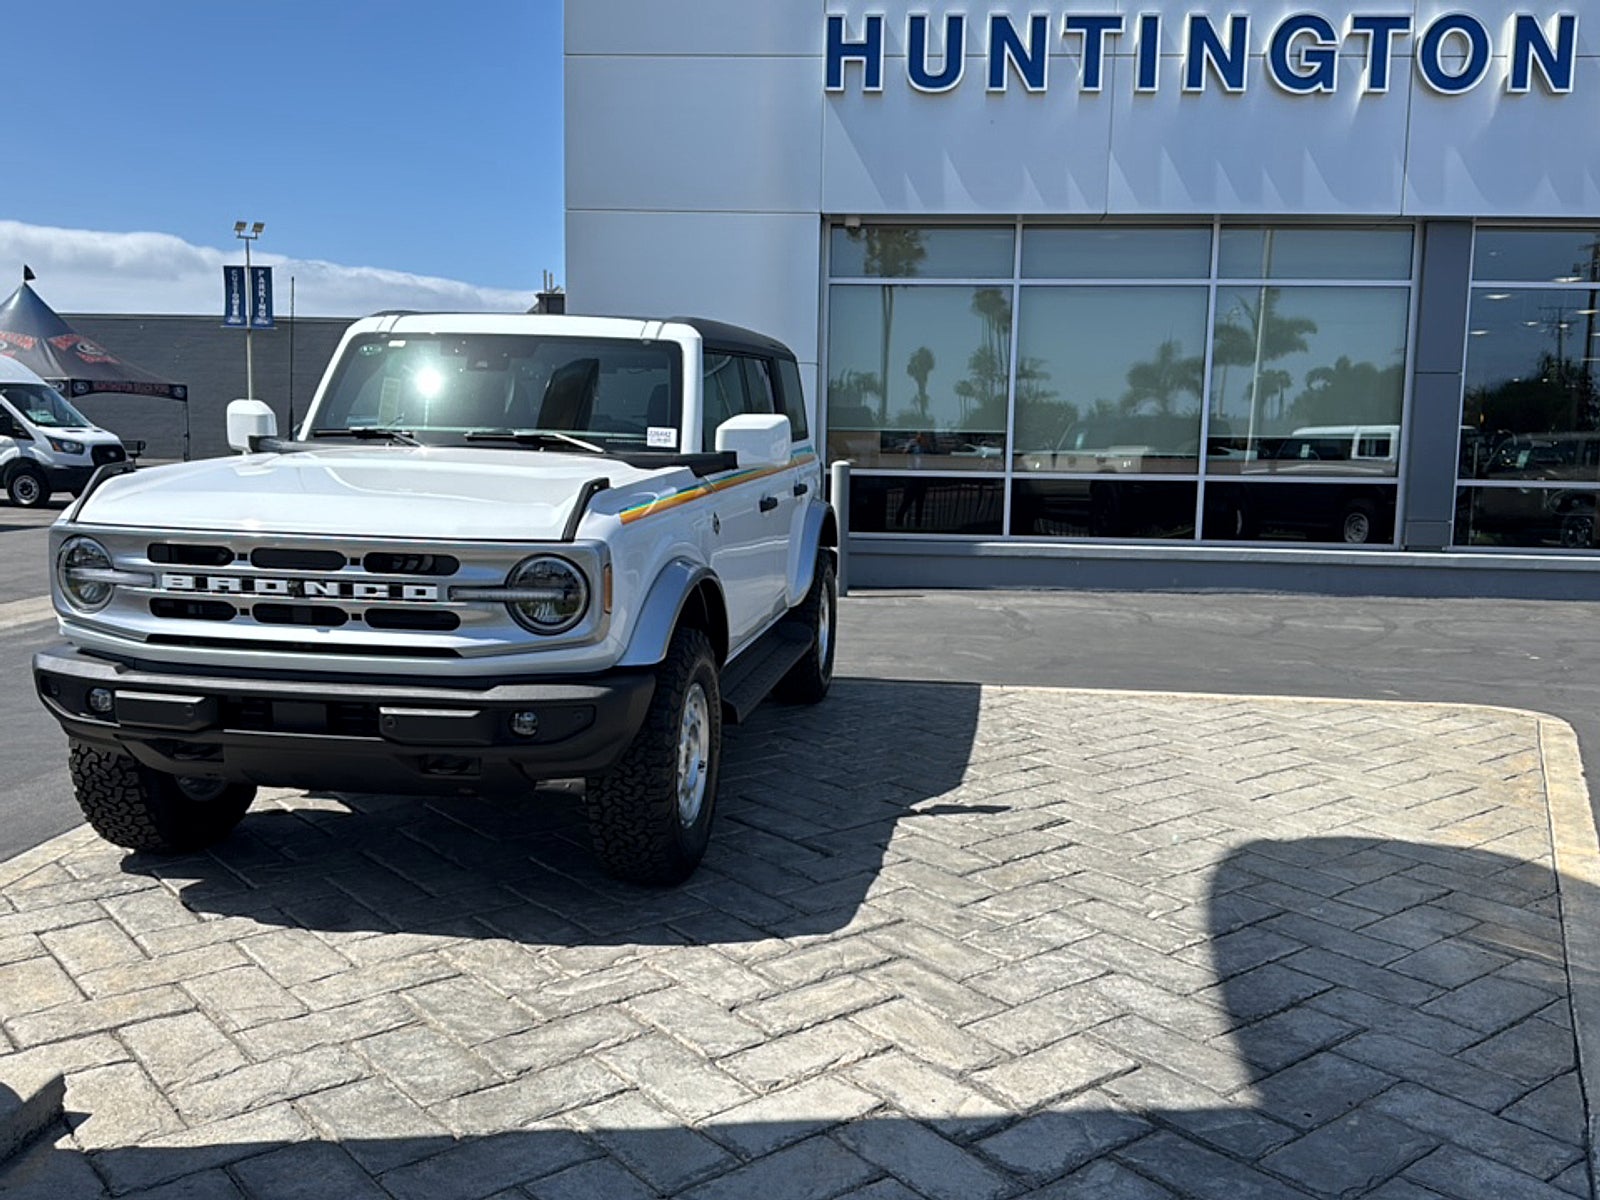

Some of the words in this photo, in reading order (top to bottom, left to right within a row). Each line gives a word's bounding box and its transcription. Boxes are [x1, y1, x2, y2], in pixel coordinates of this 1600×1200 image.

[824, 13, 1577, 94] HUNTINGTON
[258, 269, 266, 318] PARKING
[161, 573, 438, 600] BRONCO
